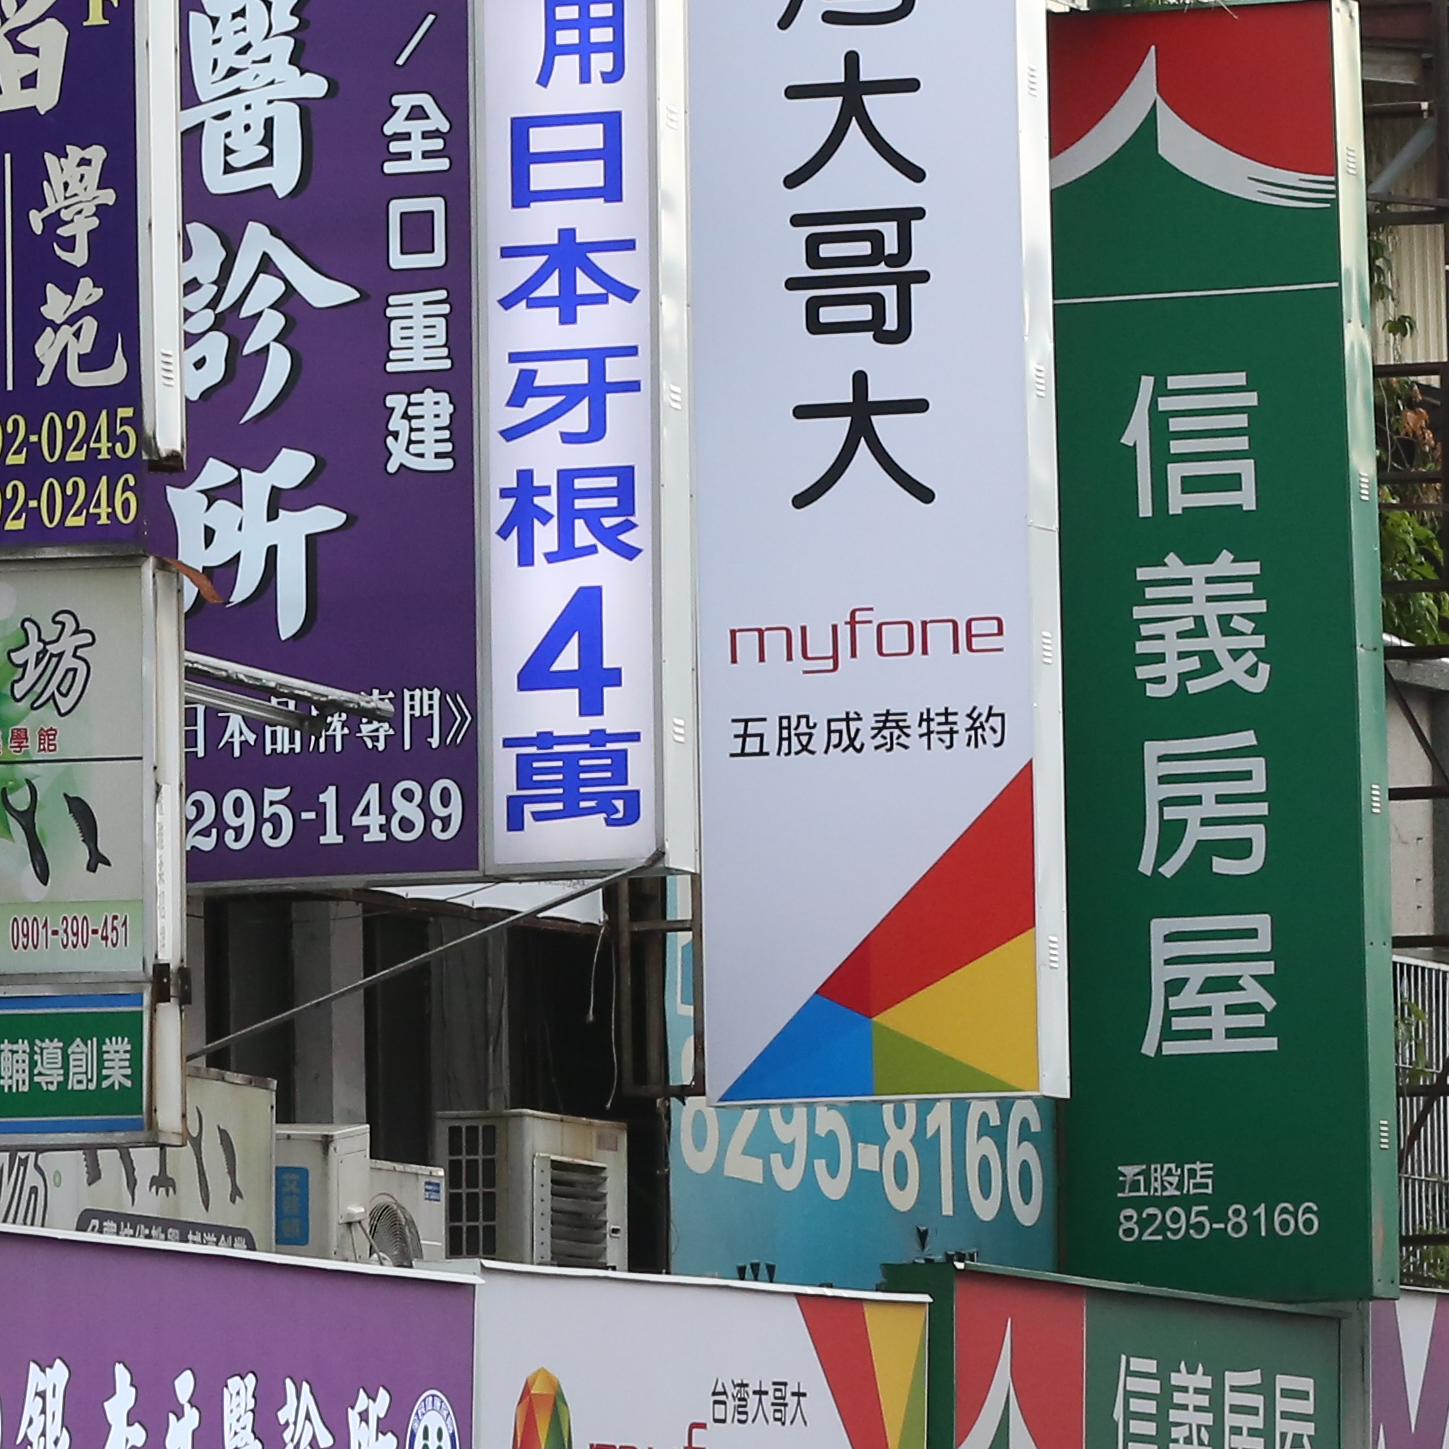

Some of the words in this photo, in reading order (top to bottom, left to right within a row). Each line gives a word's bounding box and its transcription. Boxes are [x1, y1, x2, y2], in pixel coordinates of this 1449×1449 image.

[29, 145, 128, 390] 學苑
[497, 0, 646, 834] 用日本牙根4萬
[728, 607, 1006, 675] myfone
[728, 704, 1008, 760] 五股成泰特約
[1119, 370, 1280, 1059] 信義房屋
[10, 912, 131, 952] 0901-390-451
[1117, 1162, 1214, 1197] 五股店
[1117, 1202, 1320, 1243] 8295-8166
